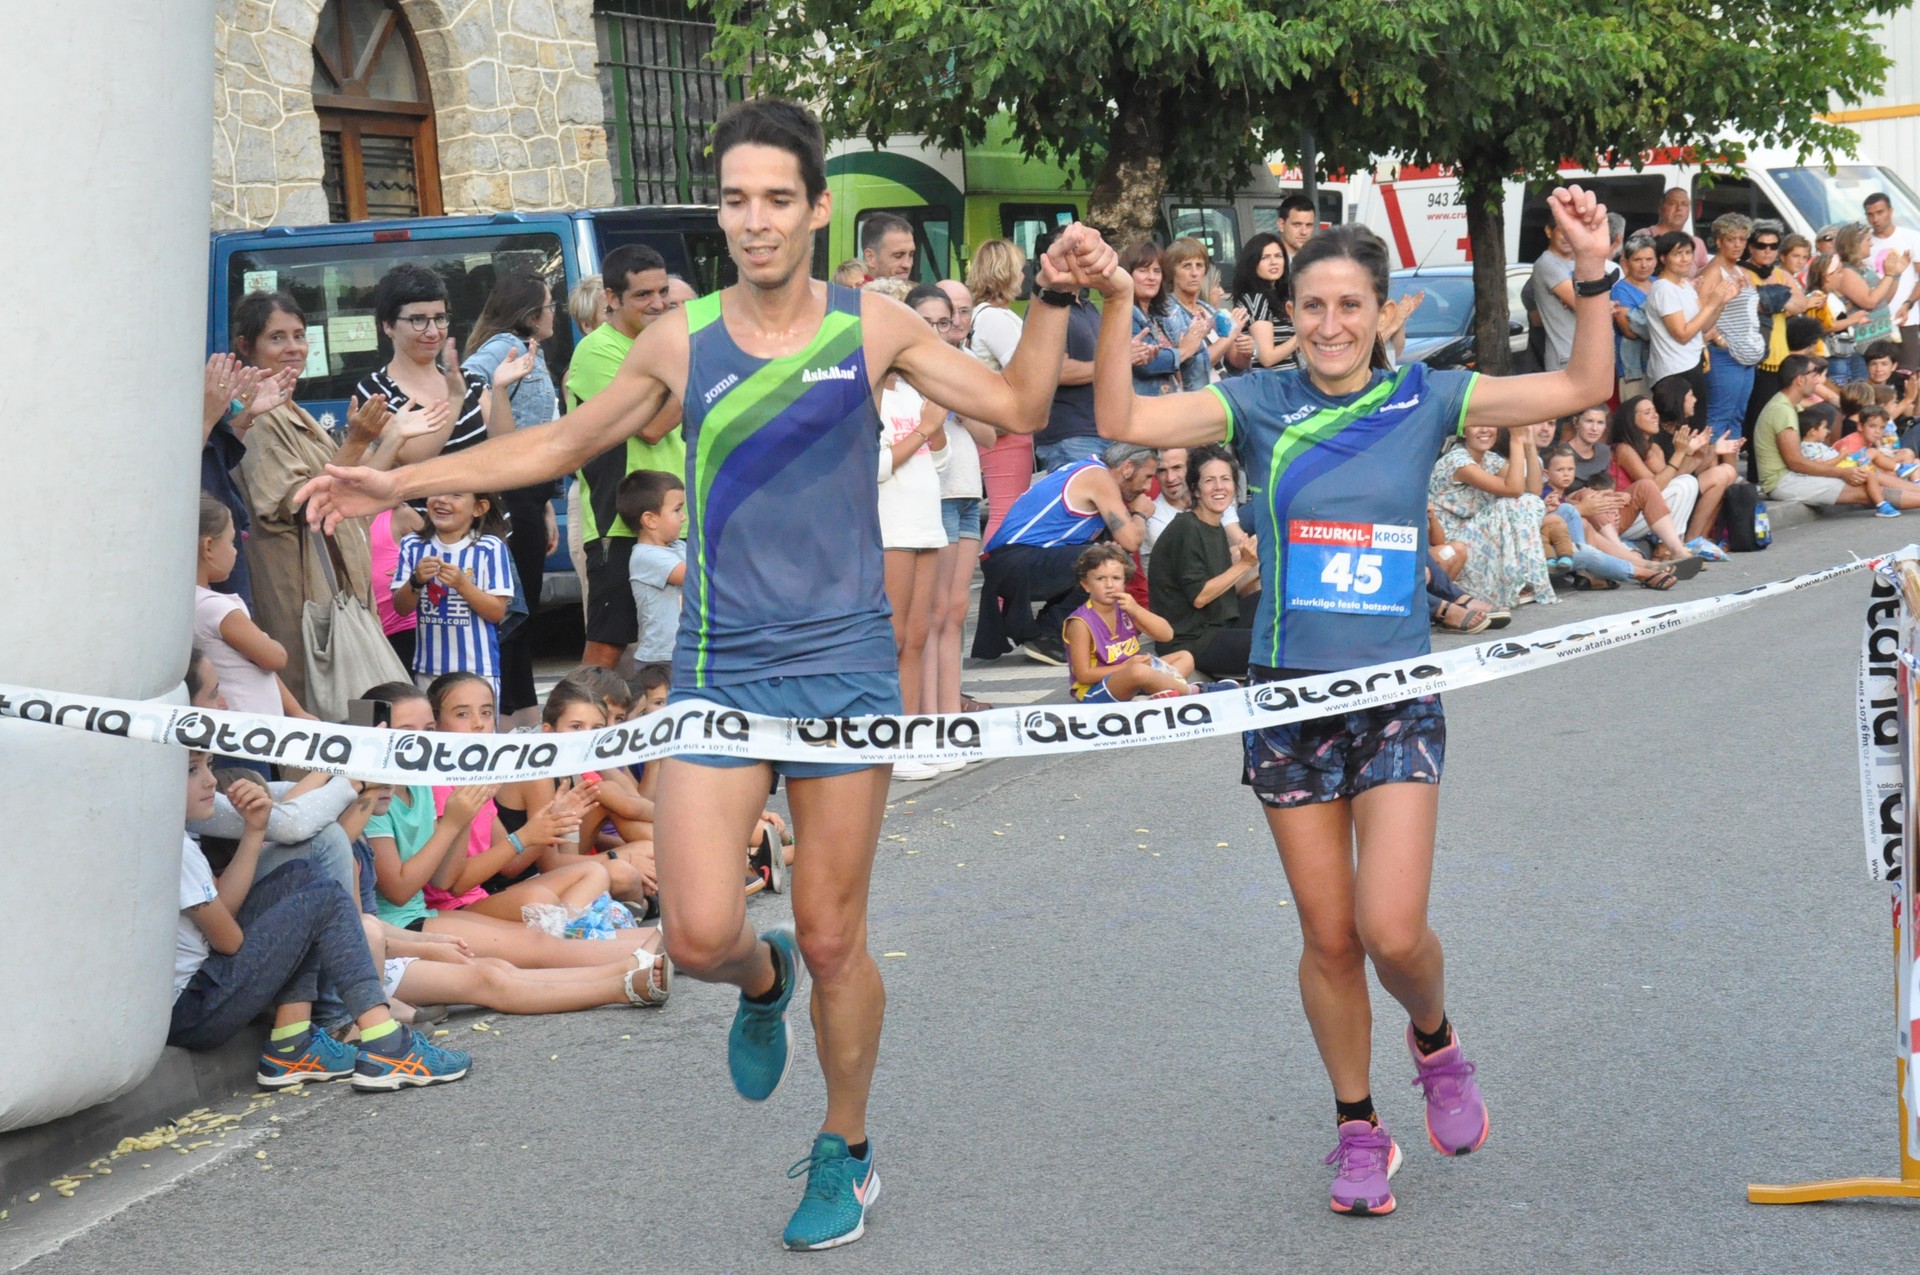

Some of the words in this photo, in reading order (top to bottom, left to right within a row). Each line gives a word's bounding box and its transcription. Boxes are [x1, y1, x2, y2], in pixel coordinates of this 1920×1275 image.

[1427, 192, 1449, 207] 943
[1427, 212, 1468, 220] www.cru
[1300, 526, 1370, 541] ZIZURKIL-
[1374, 531, 1413, 544] KROSS
[1321, 552, 1383, 595] 45
[1338, 599, 1361, 610] festa
[1362, 601, 1405, 613] batzordea
[1556, 631, 1632, 659] www.ataria.eus
[1640, 621, 1667, 638] 107.6
[1666, 617, 1682, 628] fm
[1324, 690, 1399, 713] www.ataria.eus
[1406, 682, 1433, 697] 107.6
[1432, 679, 1448, 690] fm
[175, 711, 353, 766] ataria
[594, 710, 750, 760] ataria
[796, 716, 982, 750] ataria
[1024, 702, 1213, 744] ataria
[1093, 734, 1167, 748] www.ataria.eus
[1175, 728, 1201, 739] 107.6
[1201, 726, 1216, 735] fm
[394, 733, 559, 773] ataria
[860, 752, 935, 761] www.ataria.eus
